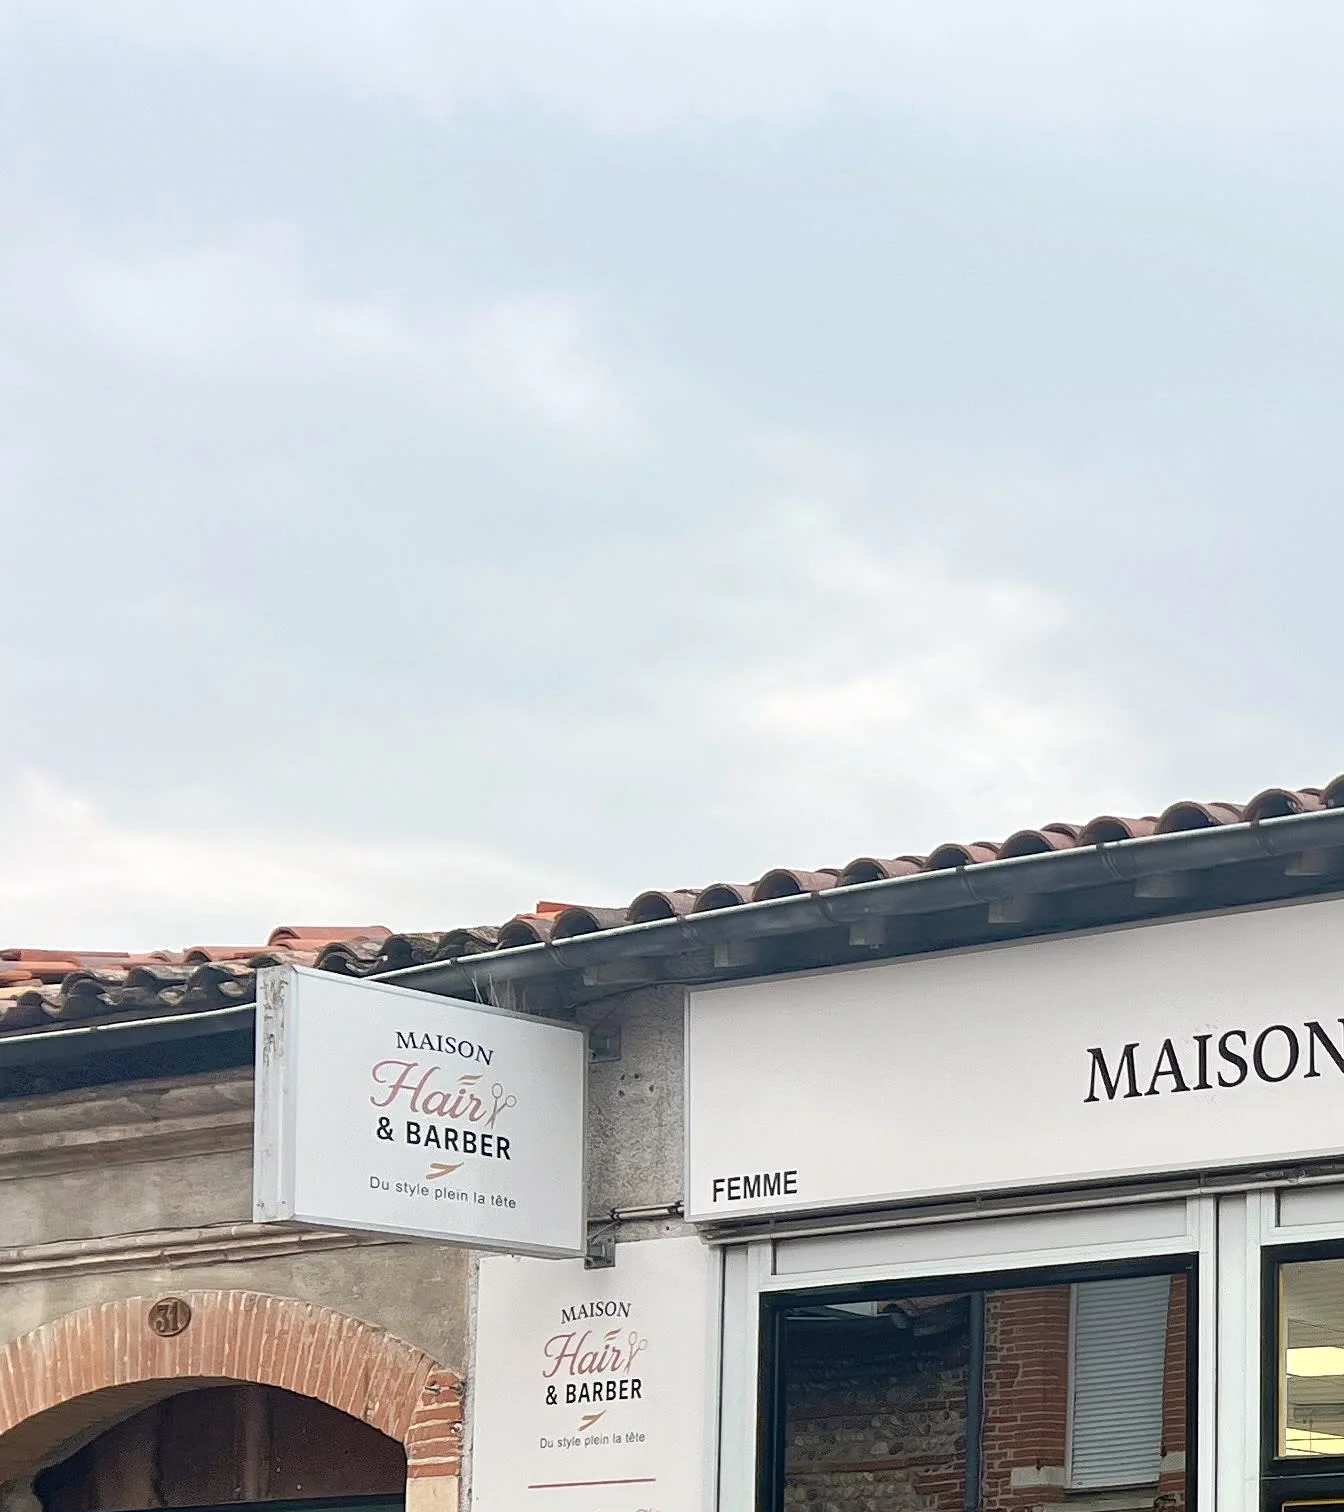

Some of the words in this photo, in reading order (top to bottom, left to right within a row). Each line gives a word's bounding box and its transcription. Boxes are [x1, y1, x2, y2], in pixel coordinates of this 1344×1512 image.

[393, 1032, 494, 1068] MAISON
[370, 1060, 489, 1124] Hair
[377, 1117, 394, 1141] &
[407, 1118, 510, 1160] BARBER
[370, 1176, 389, 1190] Du
[396, 1182, 429, 1197] style
[434, 1185, 468, 1206] plein
[473, 1190, 492, 1205] la
[495, 1193, 517, 1210] tête
[713, 1171, 797, 1202] FEMME
[156, 1302, 180, 1333] 31
[562, 1301, 631, 1324] MAISON
[542, 1330, 624, 1378] Hair
[546, 1385, 557, 1405] &
[566, 1379, 641, 1403] BARBER
[540, 1438, 553, 1448] Du
[558, 1437, 581, 1449] style
[585, 1434, 609, 1448] plein
[613, 1433, 621, 1443] la
[625, 1432, 645, 1443] tête
